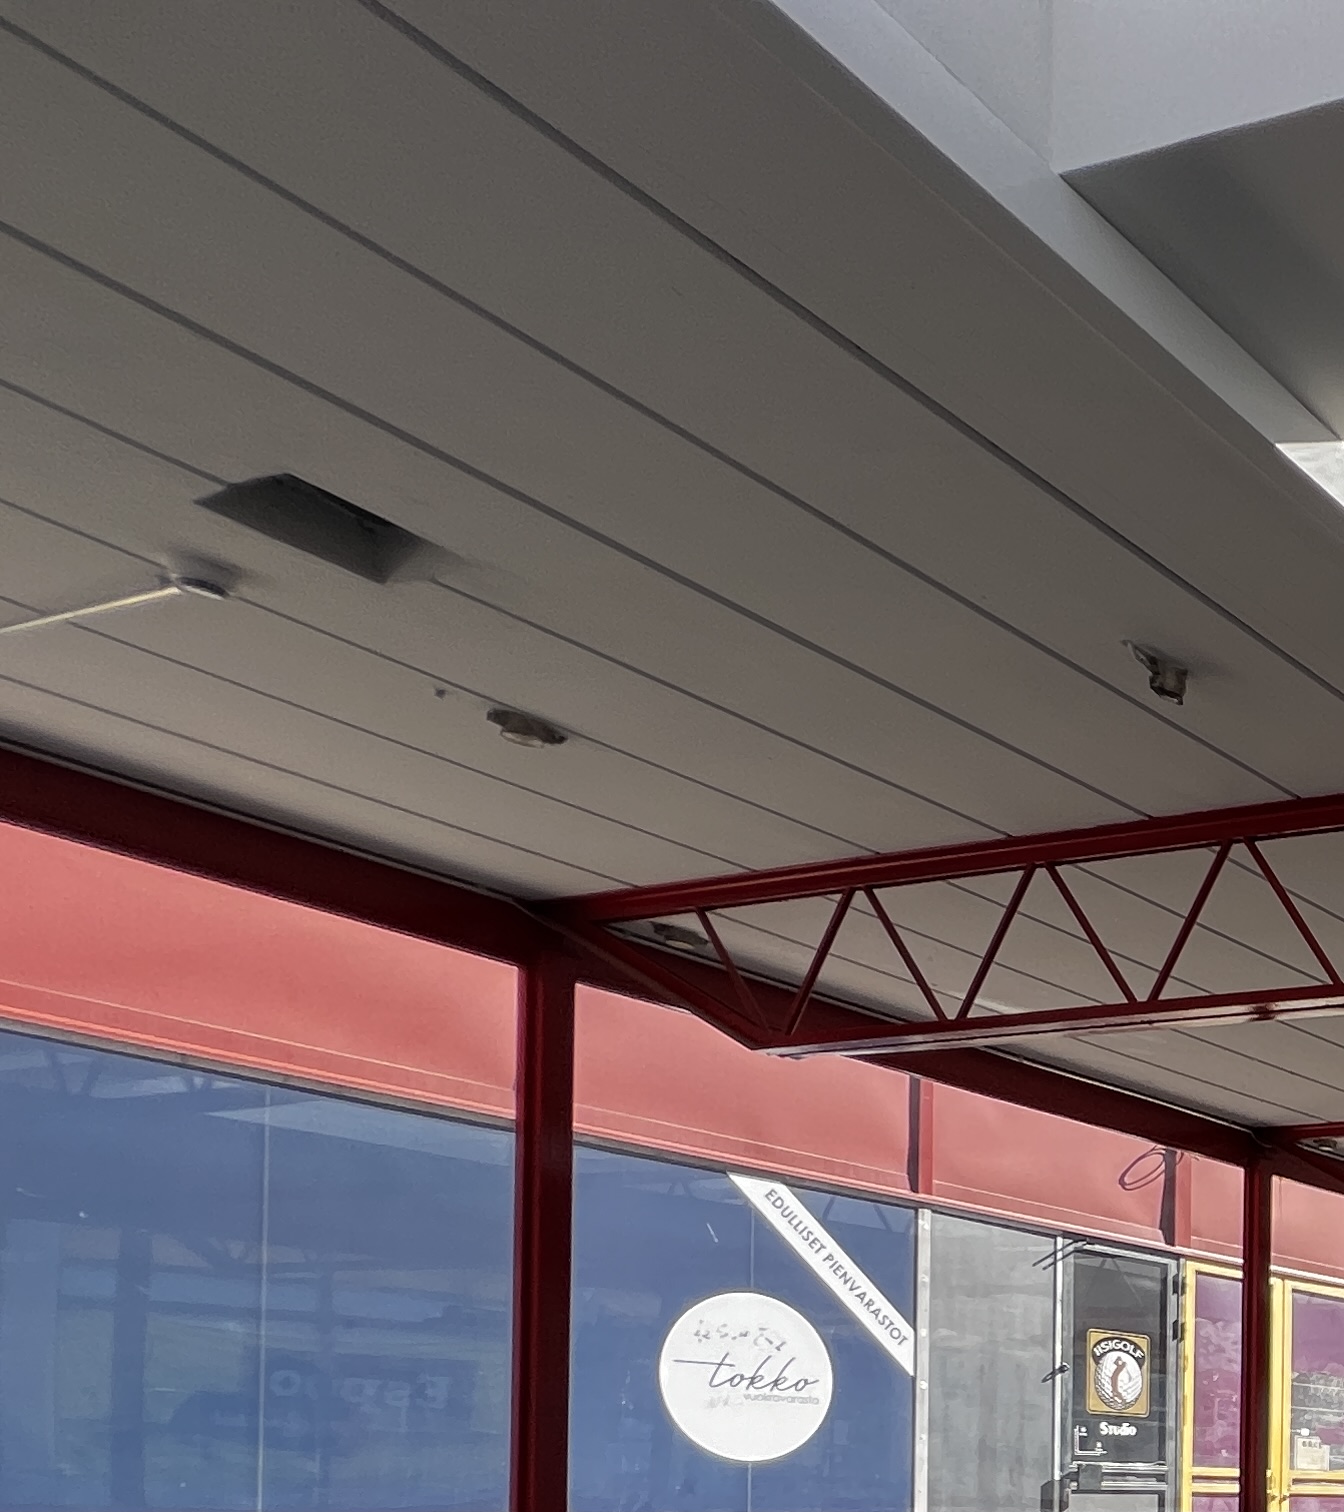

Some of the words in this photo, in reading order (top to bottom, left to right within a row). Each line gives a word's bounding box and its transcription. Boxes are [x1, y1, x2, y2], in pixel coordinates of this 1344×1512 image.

[765, 1189, 827, 1254] EDULLISET
[822, 1253, 909, 1346] PIENVARASTOT
[672, 1352, 820, 1392] tokko
[1099, 1421, 1138, 1436] Studio
